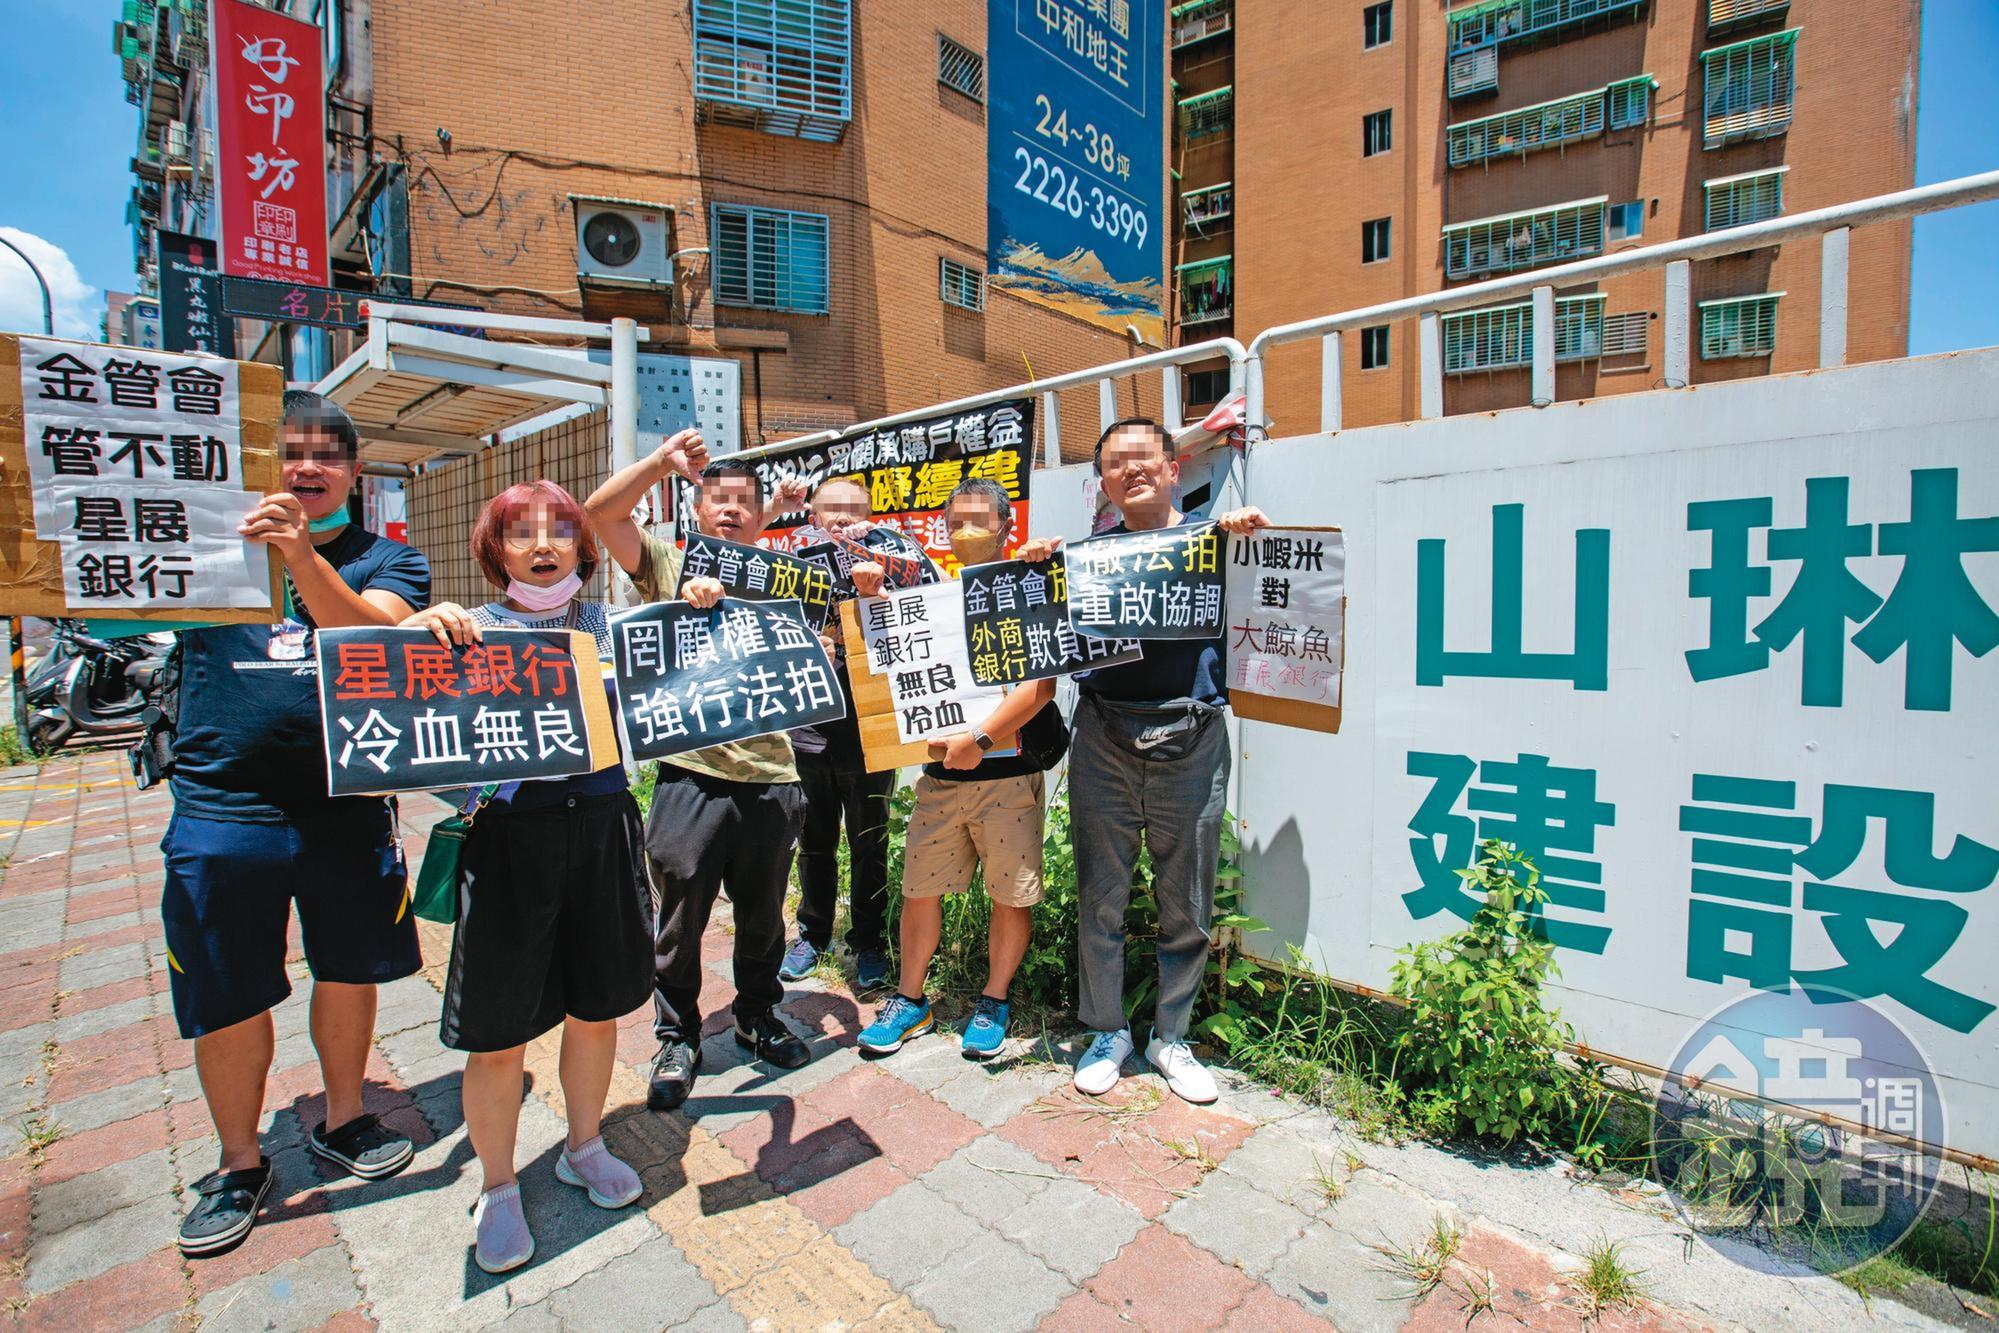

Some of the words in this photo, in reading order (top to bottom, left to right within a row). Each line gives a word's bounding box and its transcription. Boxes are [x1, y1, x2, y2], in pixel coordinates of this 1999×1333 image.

[1036, 0, 1130, 88] 中和地王
[236, 33, 300, 200] 好印坊
[1014, 147, 1148, 250] 2226-3399
[280, 288, 352, 324] 名片
[36, 352, 225, 415] 金管會
[41, 425, 228, 482] 管不動
[74, 496, 191, 543] 星展
[76, 552, 194, 598] 銀行
[683, 540, 830, 606] 金管會放任
[1232, 536, 1324, 571] 小蝦米
[869, 595, 929, 631] 星展
[1078, 581, 1222, 627] 重啟協調
[1261, 577, 1291, 609] 對
[621, 607, 815, 678] 罔顧權益
[873, 630, 933, 667] 銀行
[971, 617, 1023, 653] 外商
[1232, 618, 1333, 664] 大鯨魚
[334, 643, 572, 701] 星展銀行
[896, 663, 957, 700] 無良
[973, 649, 1027, 684] 銀行
[630, 658, 835, 745] 強行法拍
[902, 700, 966, 735] 冷血
[337, 702, 584, 774] 冷血無良
